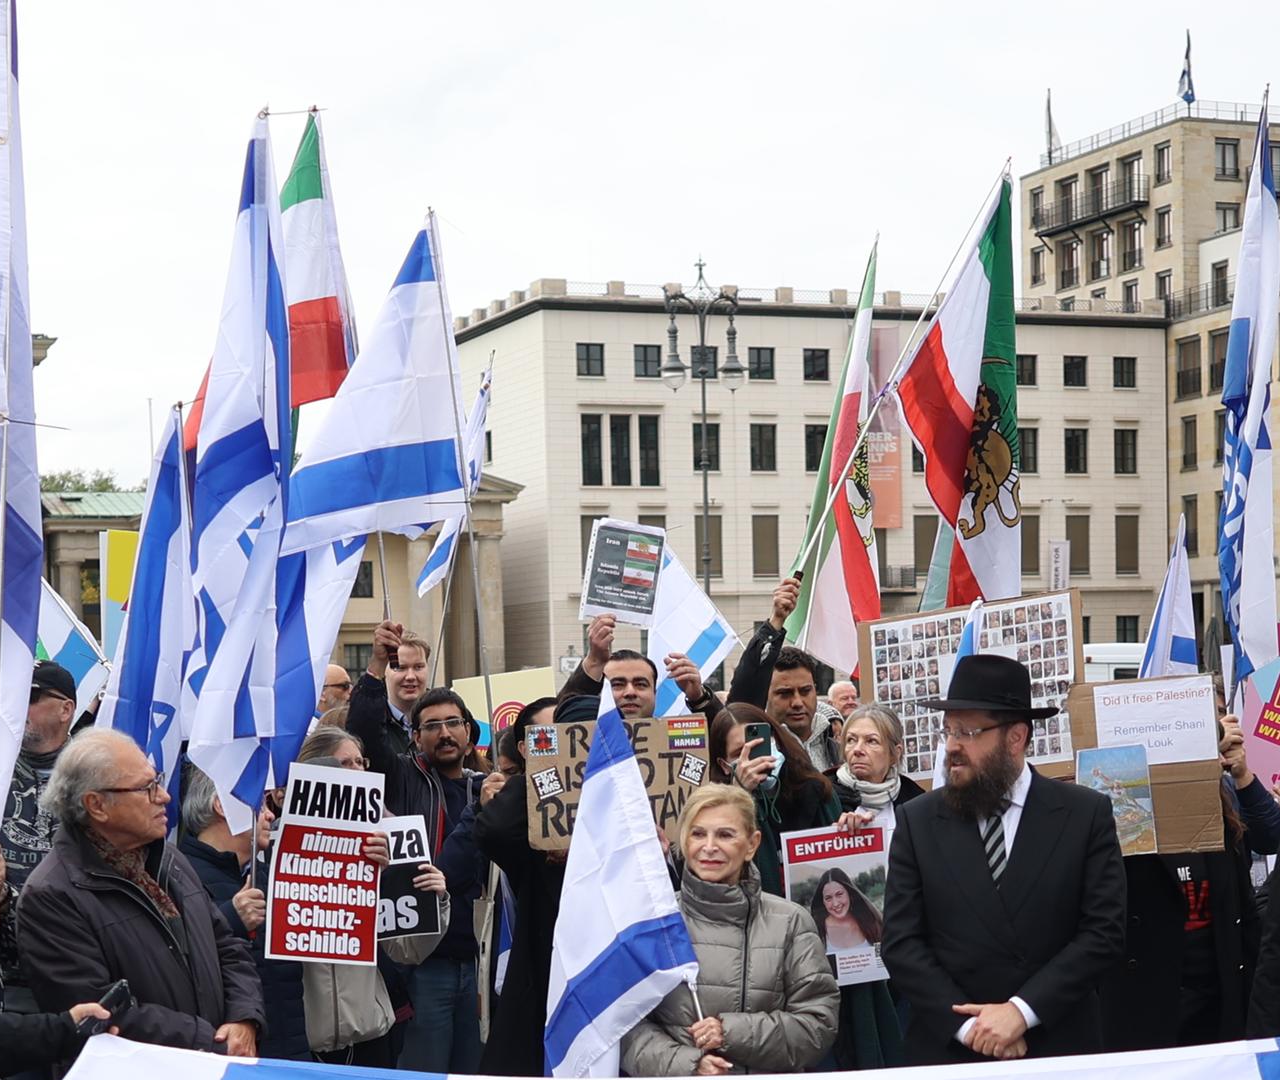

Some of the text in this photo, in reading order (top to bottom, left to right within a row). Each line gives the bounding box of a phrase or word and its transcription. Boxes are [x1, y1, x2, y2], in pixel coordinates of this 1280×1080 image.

[605, 537, 621, 546] Iran
[1103, 687, 1211, 706] Did it free Palestine?
[1114, 719, 1206, 736] Remember Shani
[674, 738, 701, 748] HAMAS
[1148, 738, 1174, 748] Louk
[288, 779, 382, 824] HAMAS
[301, 831, 363, 856] nimmt
[389, 828, 426, 862] za
[794, 834, 875, 857] ENTFÜHRT
[21, 851, 38, 864] TO
[279, 853, 375, 882] Kinder als
[274, 880, 376, 908] menschliche
[287, 902, 362, 930] Schutz-
[285, 930, 361, 956] schilde
